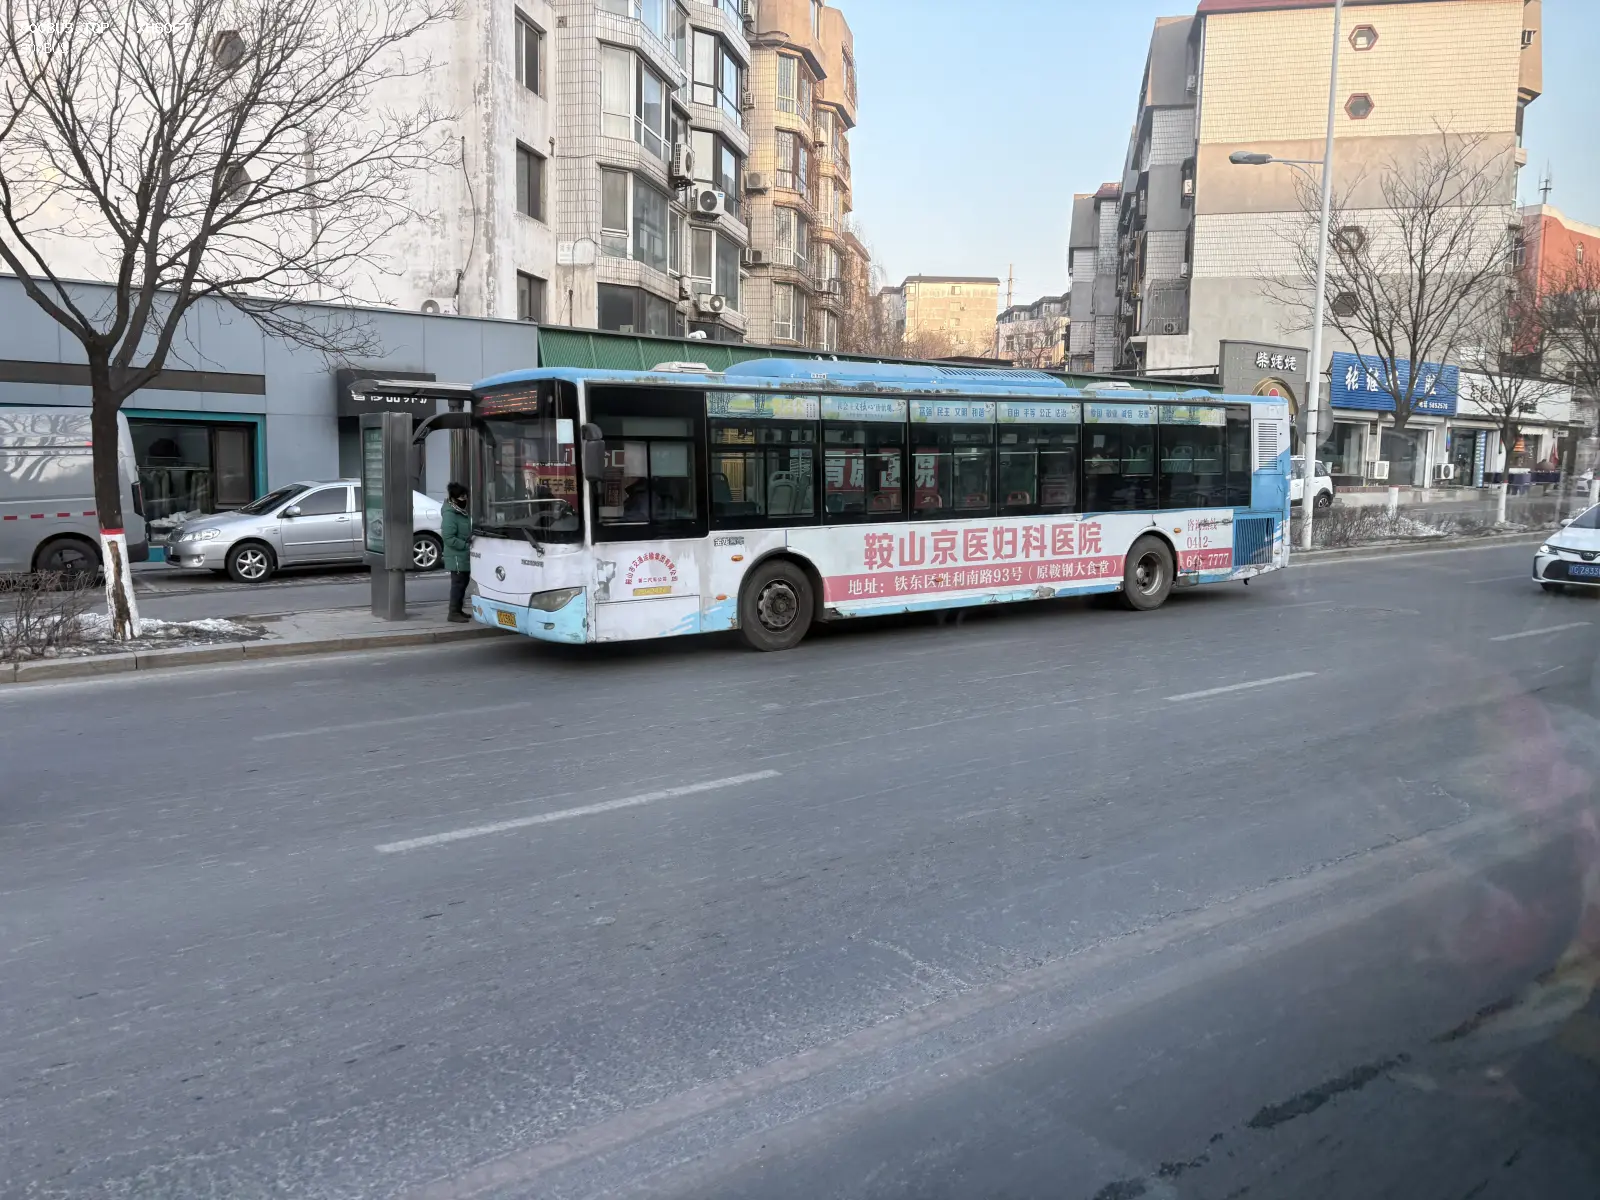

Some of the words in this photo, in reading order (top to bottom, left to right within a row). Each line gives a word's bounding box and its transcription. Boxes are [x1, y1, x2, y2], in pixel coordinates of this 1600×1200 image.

[1256, 352, 1296, 371] 柴姥姥
[937, 407, 950, 416] 民主
[955, 407, 967, 417] 文明
[972, 407, 985, 417] 和谐
[1008, 408, 1019, 418] 自由
[1024, 408, 1035, 418] 平等
[1040, 408, 1051, 418] 公正
[1056, 408, 1067, 418] 法治
[863, 522, 1102, 570] 鞍山京医妇科医院
